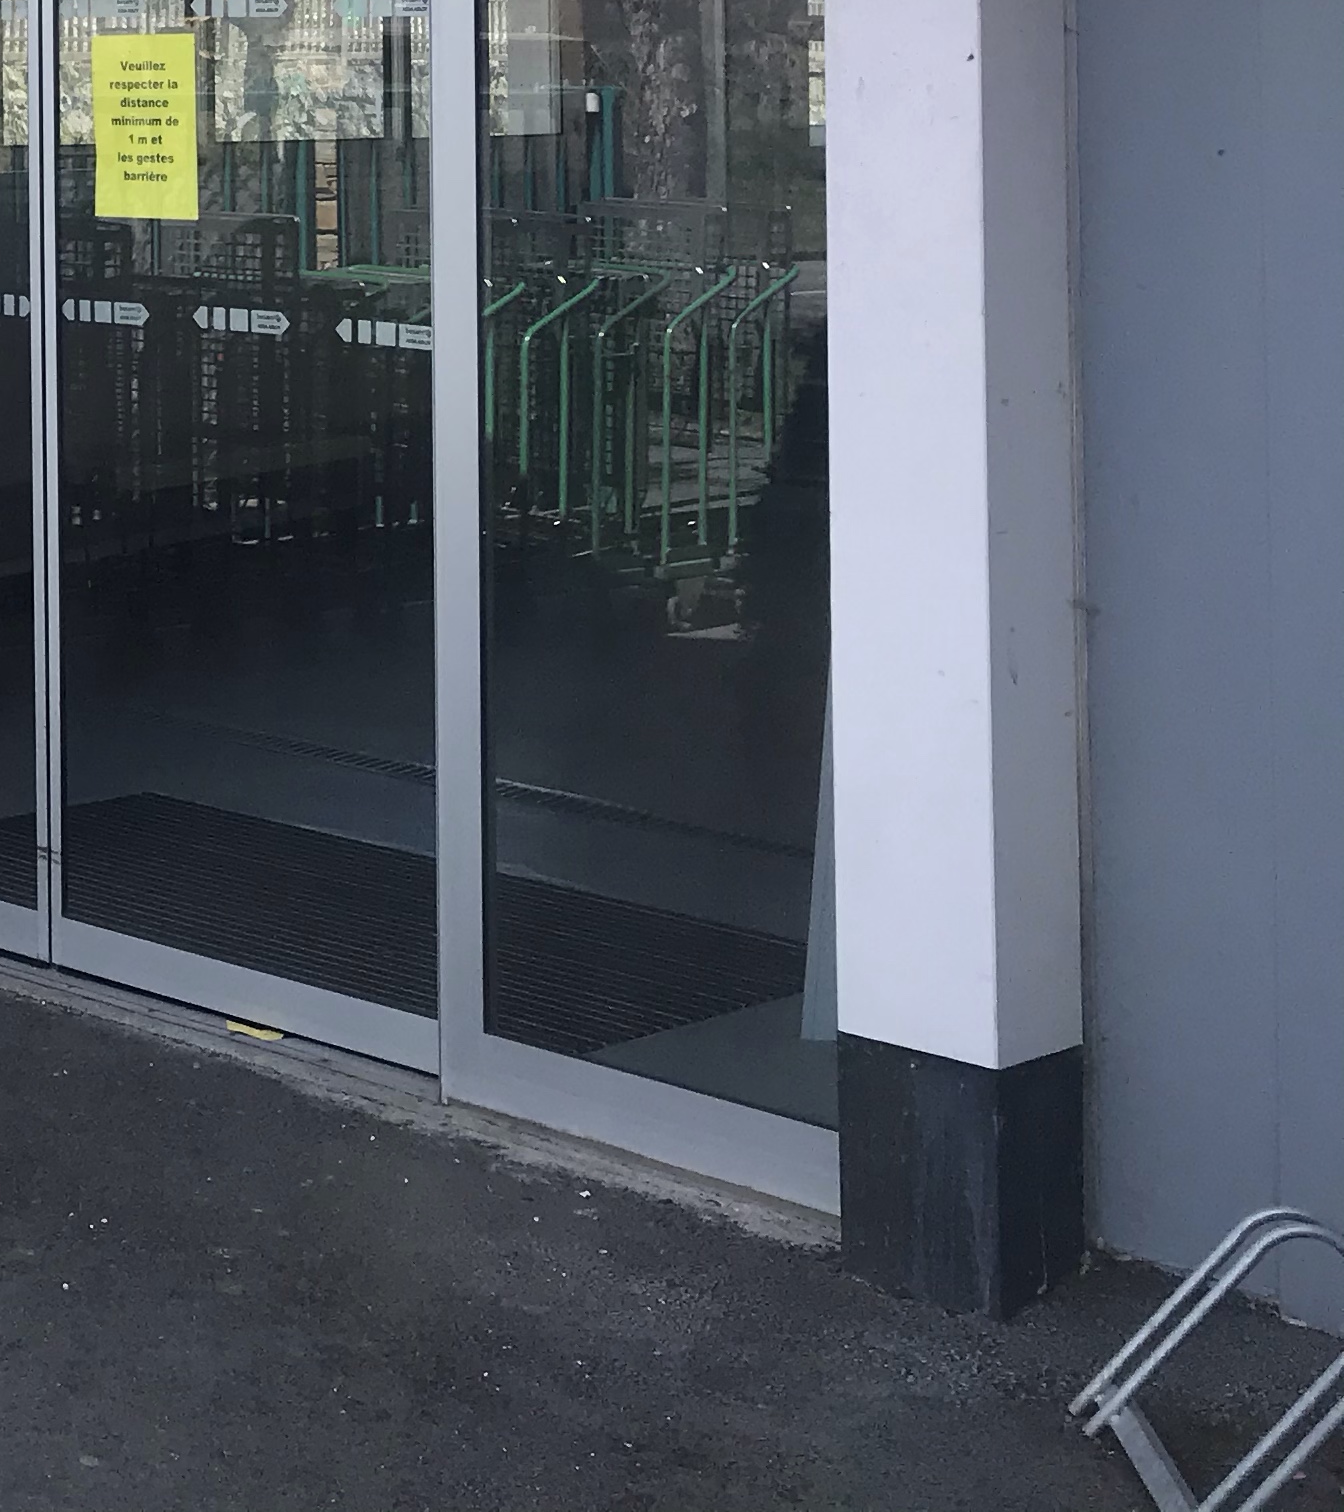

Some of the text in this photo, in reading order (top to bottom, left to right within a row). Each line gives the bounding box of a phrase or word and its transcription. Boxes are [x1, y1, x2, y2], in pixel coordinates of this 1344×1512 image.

[120, 60, 166, 71] Veuillez
[109, 79, 179, 92] respecter la
[120, 97, 169, 108] distance
[111, 115, 179, 127] minimum de
[137, 136, 148, 144] m
[150, 134, 163, 145] et
[117, 152, 175, 166] les gestes
[123, 170, 168, 182] barrière
